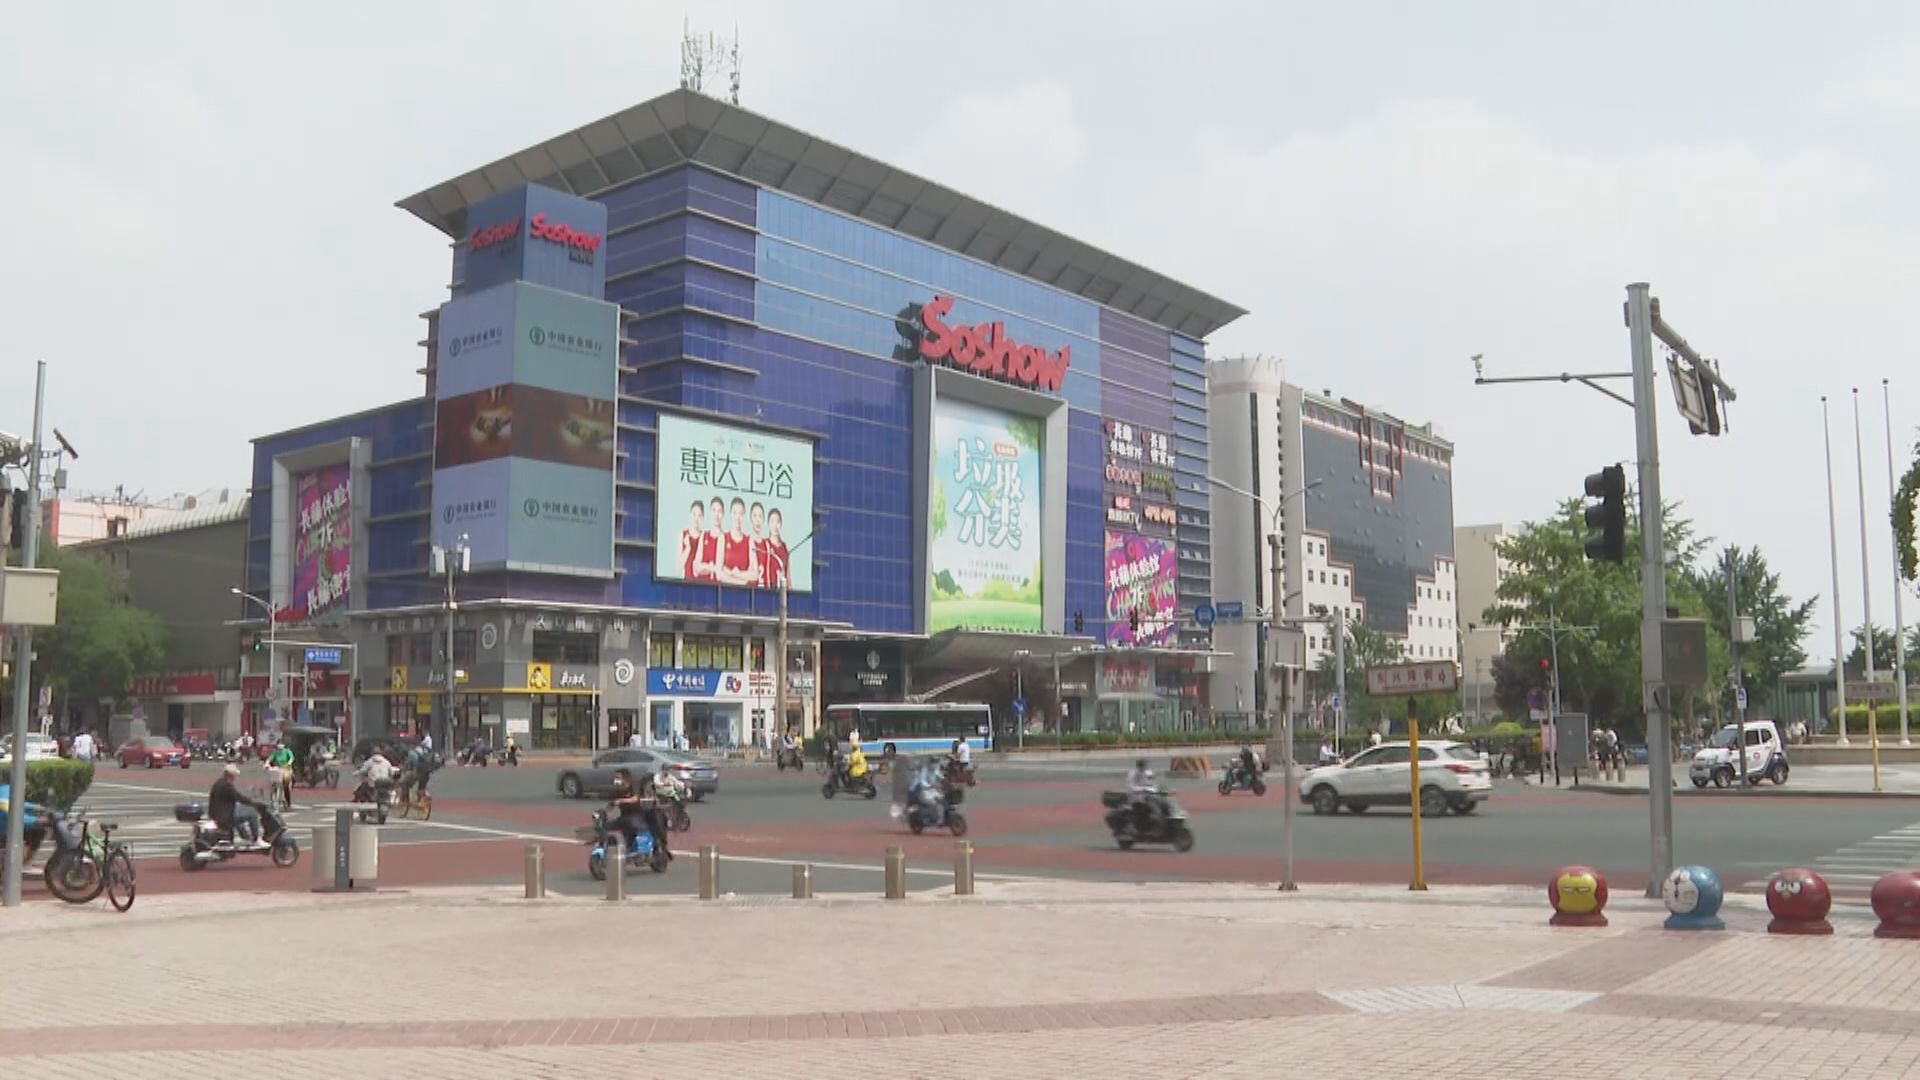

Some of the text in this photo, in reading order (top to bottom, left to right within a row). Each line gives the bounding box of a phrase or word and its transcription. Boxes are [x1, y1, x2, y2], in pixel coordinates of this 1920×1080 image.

[547, 330, 602, 352] 中国农业银行
[680, 447, 793, 499] 惠达卫浴
[953, 436, 1024, 501] 垃圾
[542, 501, 598, 518] 中国农业银行
[953, 486, 1024, 551] 分类
[676, 674, 705, 687] 中国电信
